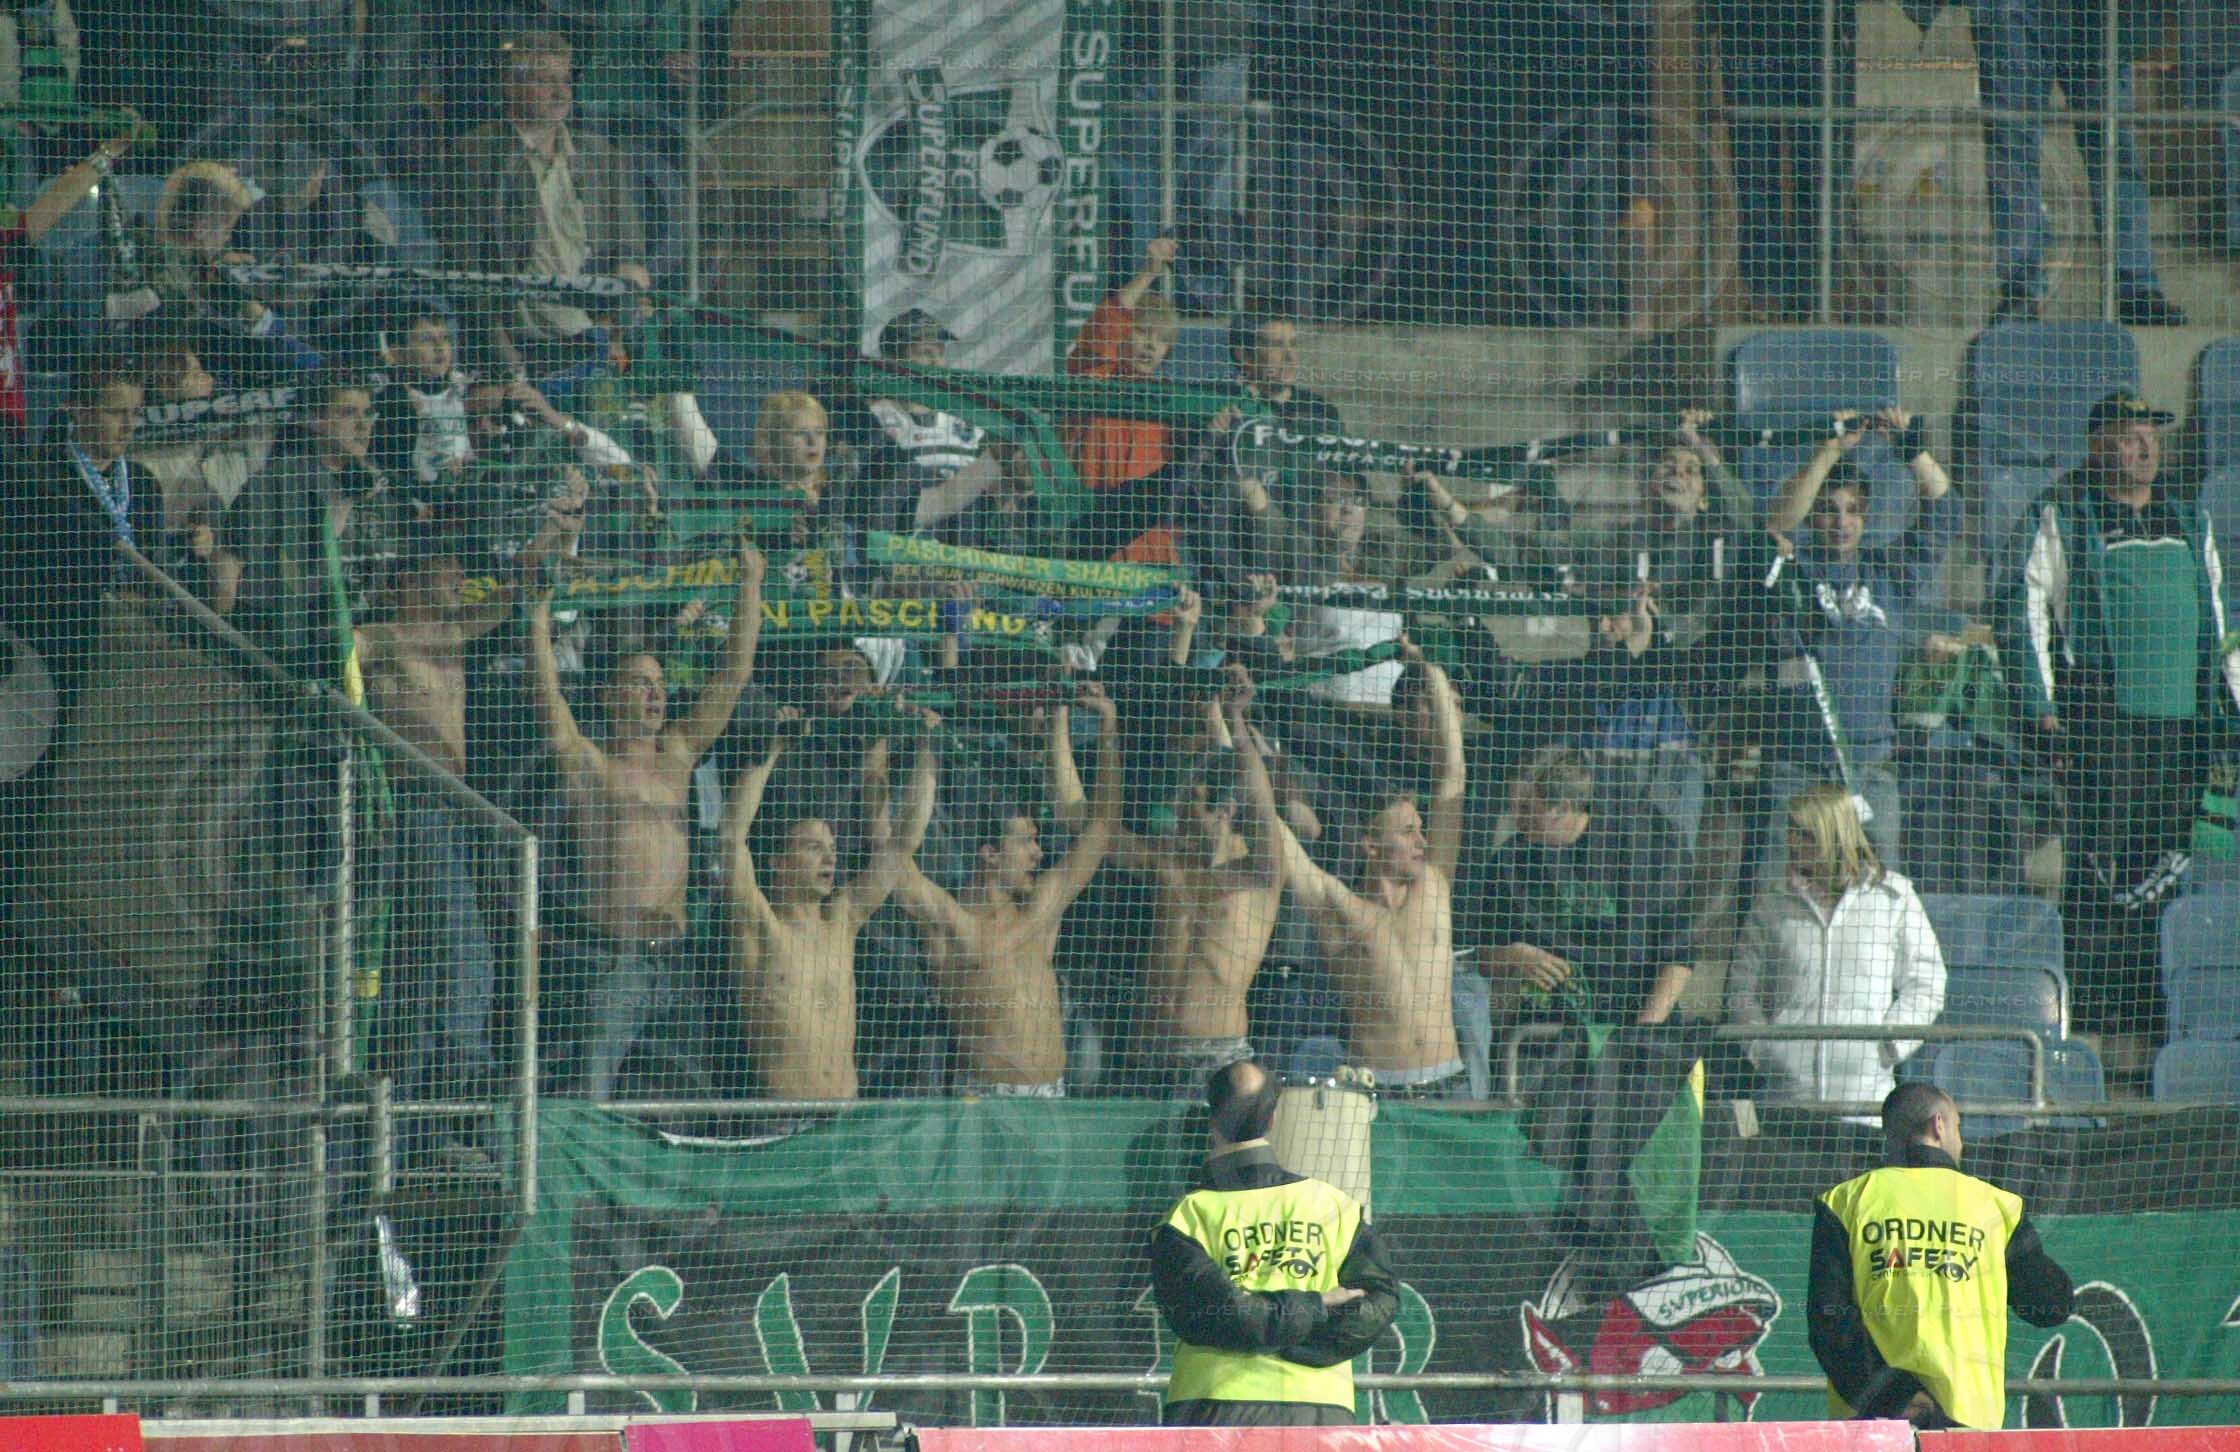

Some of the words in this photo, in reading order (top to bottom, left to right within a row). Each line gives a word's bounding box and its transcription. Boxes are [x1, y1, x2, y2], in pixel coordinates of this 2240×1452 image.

[1224, 1220, 1323, 1252] ORDNER
[1862, 1217, 1985, 1252] ORDNER
[1870, 1246, 1978, 1273] SAFETY
